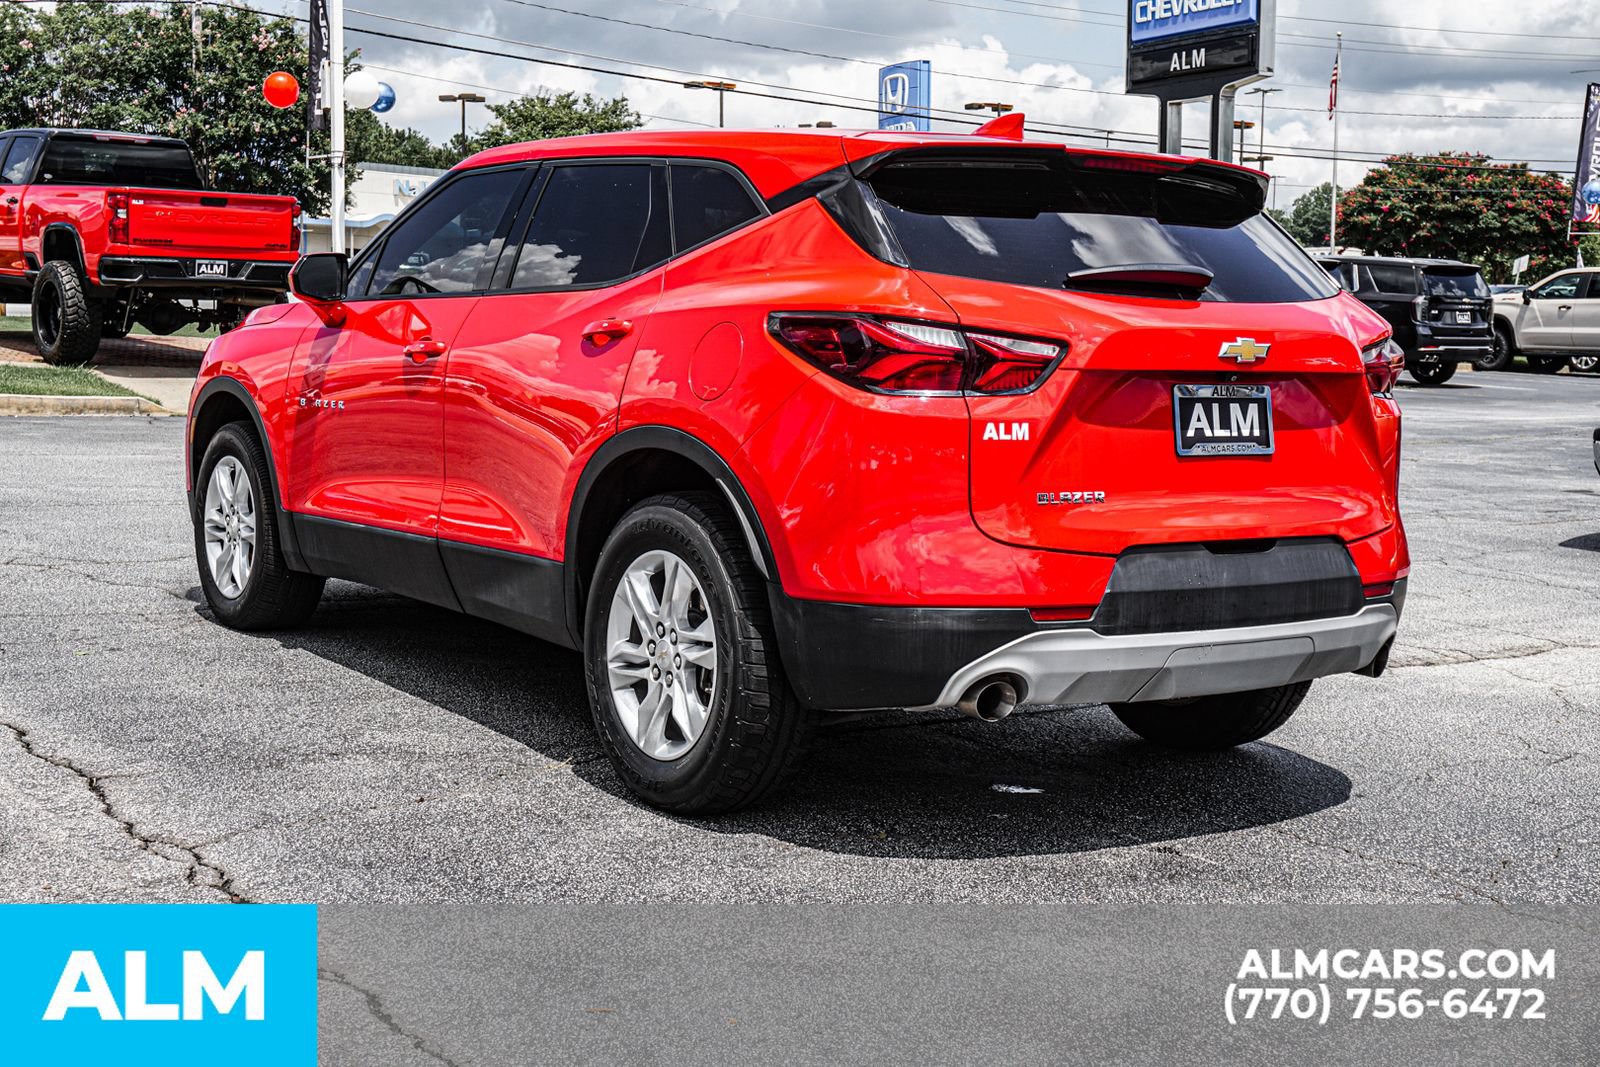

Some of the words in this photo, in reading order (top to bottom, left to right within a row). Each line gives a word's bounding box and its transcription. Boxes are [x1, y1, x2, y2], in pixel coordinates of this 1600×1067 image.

[1170, 48, 1206, 72] ALM
[198, 264, 225, 274] ALM
[1212, 385, 1237, 397] ALM
[1186, 402, 1261, 437] ALM
[982, 422, 1030, 441] ALM
[1201, 444, 1253, 453] ALMCARS.COM
[1036, 491, 1105, 505] BLAZER
